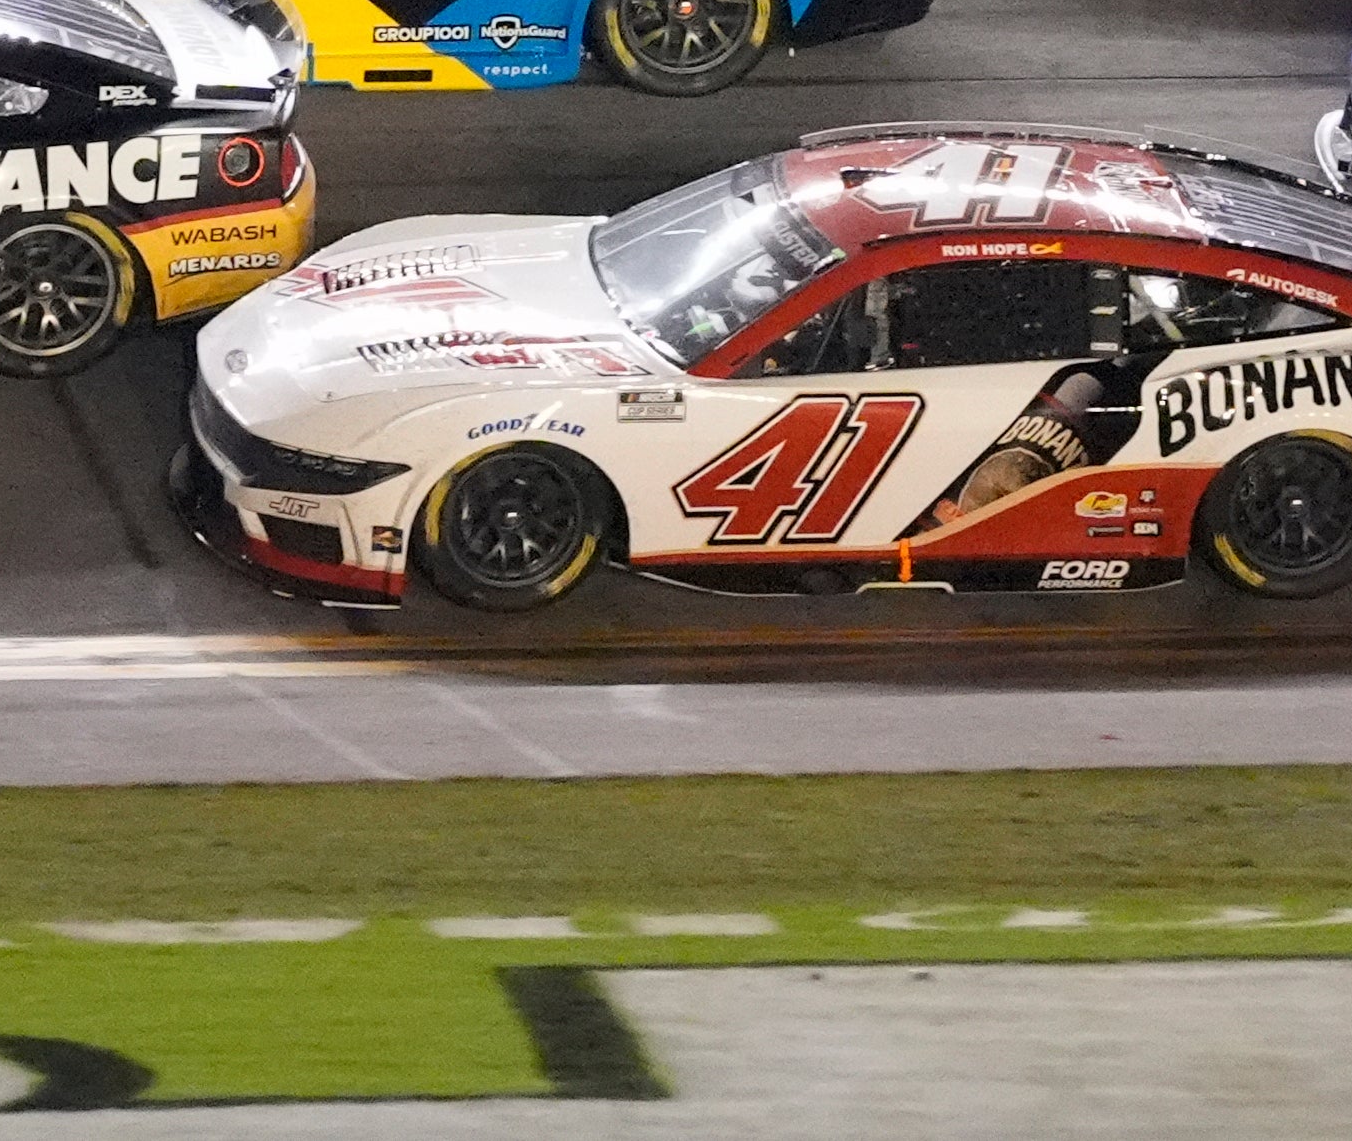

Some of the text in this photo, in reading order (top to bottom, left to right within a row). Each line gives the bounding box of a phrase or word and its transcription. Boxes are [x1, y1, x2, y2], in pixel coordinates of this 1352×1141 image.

[374, 24, 567, 42] GROUP1001 NationsGuard
[99, 85, 149, 101] DEX
[849, 140, 1075, 232] 41
[171, 223, 278, 247] WABASH
[942, 242, 1028, 257] RON HOPE
[169, 251, 281, 278] MENARDS
[1247, 271, 1339, 308] AUTODESK
[467, 412, 586, 440] GOODEAR
[671, 392, 926, 546] 41
[1041, 560, 1131, 581] FORD
[1037, 578, 1125, 589] PERFORMANCE
